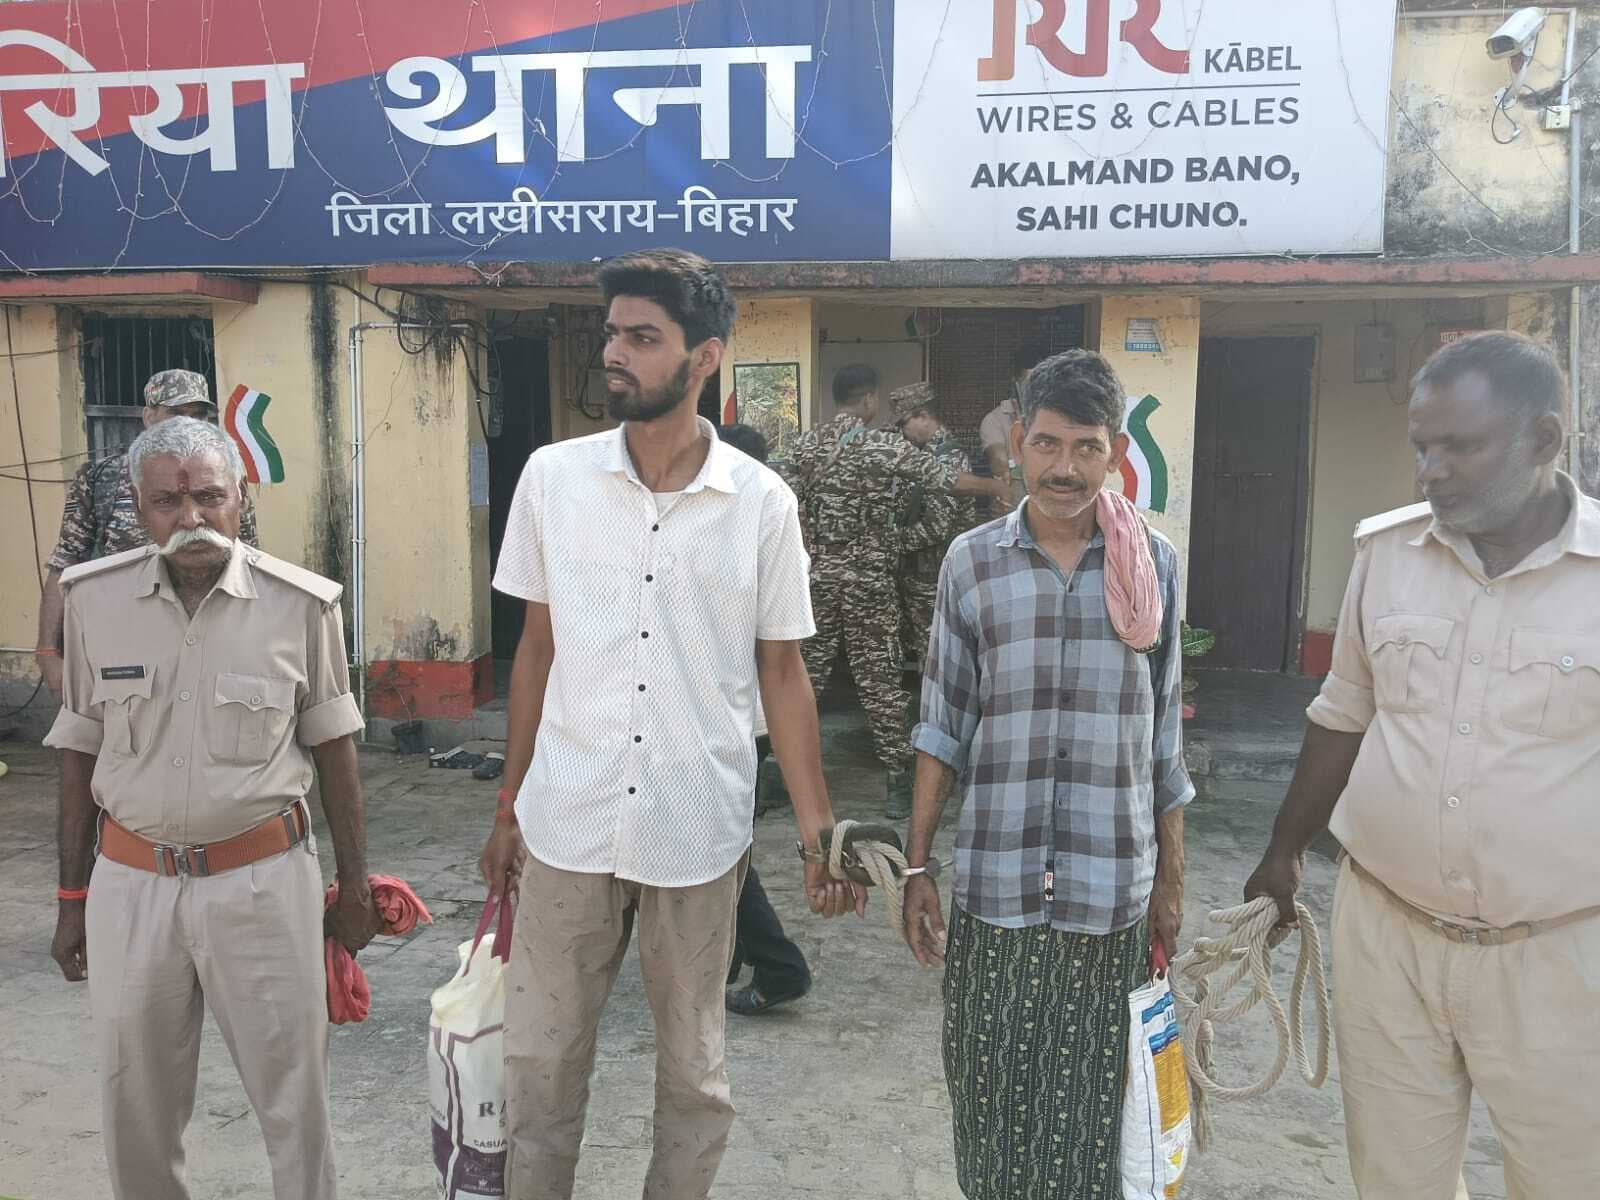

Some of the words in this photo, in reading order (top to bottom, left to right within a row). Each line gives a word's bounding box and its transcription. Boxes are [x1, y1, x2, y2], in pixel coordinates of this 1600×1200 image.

[1205, 43, 1302, 73] KĀBEL
[384, 45, 812, 164] थाना
[976, 104, 1097, 134] WIRES
[1110, 102, 1133, 130] &
[1148, 97, 1299, 128] CABLES
[971, 159, 1174, 188] AKALMAND
[1185, 155, 1300, 186] BANO,
[325, 191, 432, 237] जिला
[444, 186, 799, 237] लखीसराय-बिहार
[1016, 204, 1098, 232] SAHI
[1109, 202, 1248, 230] CHUNO.
